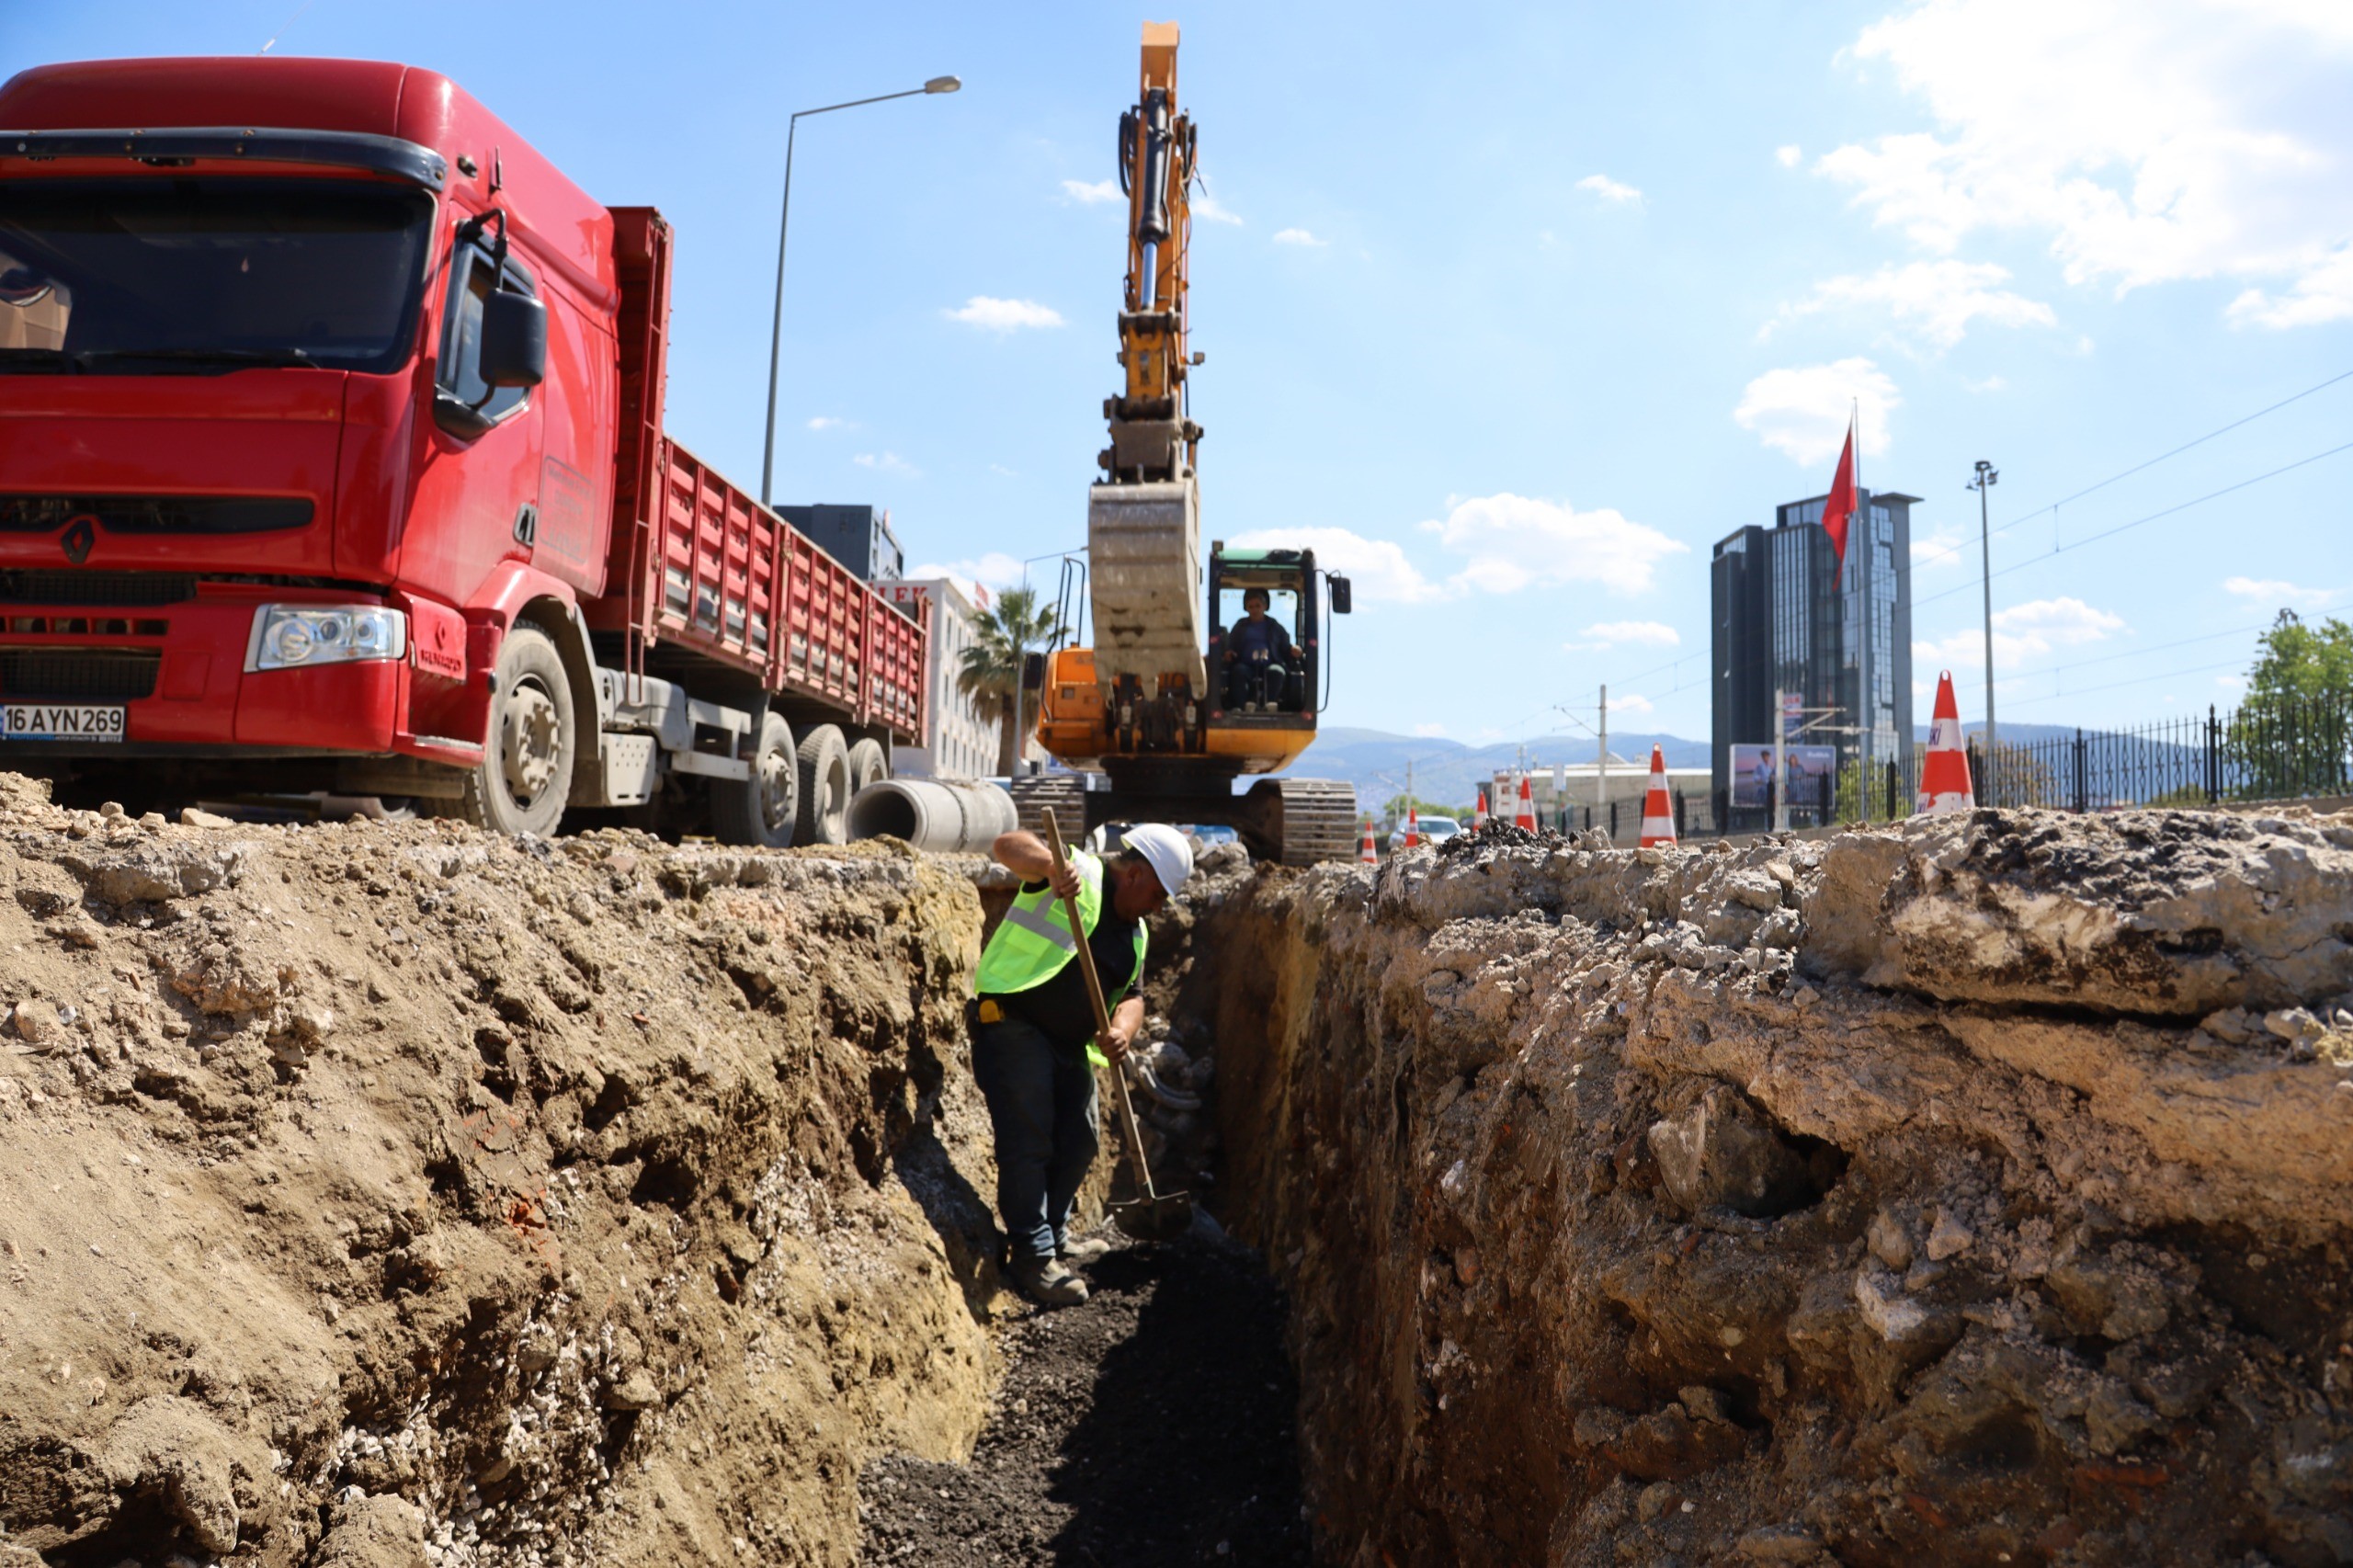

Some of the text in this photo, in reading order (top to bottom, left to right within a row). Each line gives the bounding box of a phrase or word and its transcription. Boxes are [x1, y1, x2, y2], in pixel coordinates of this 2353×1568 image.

[6, 708, 122, 733] 16 AYN 269
